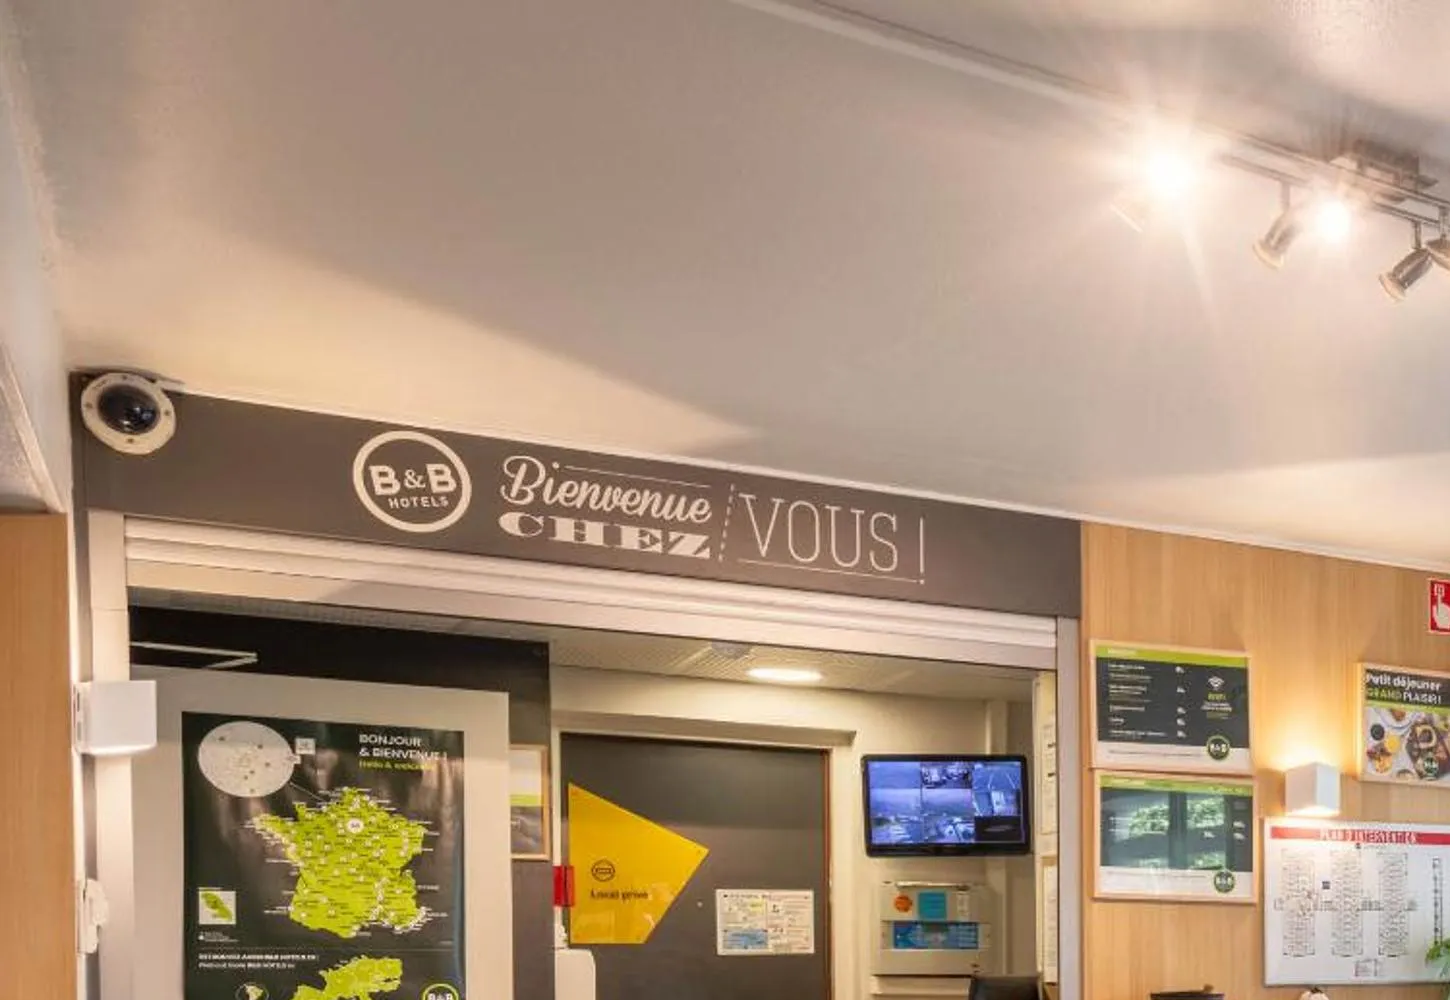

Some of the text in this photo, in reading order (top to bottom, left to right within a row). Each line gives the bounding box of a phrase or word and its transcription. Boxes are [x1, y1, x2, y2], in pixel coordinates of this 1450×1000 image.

[369, 463, 457, 496] B&B
[500, 455, 712, 524] Bienvenue
[388, 496, 449, 509] HOTELS
[499, 511, 710, 560] CHEZ
[738, 493, 898, 572] VOUS
[359, 734, 423, 747] BONJOUR
[373, 747, 440, 761] BIENVENUE
